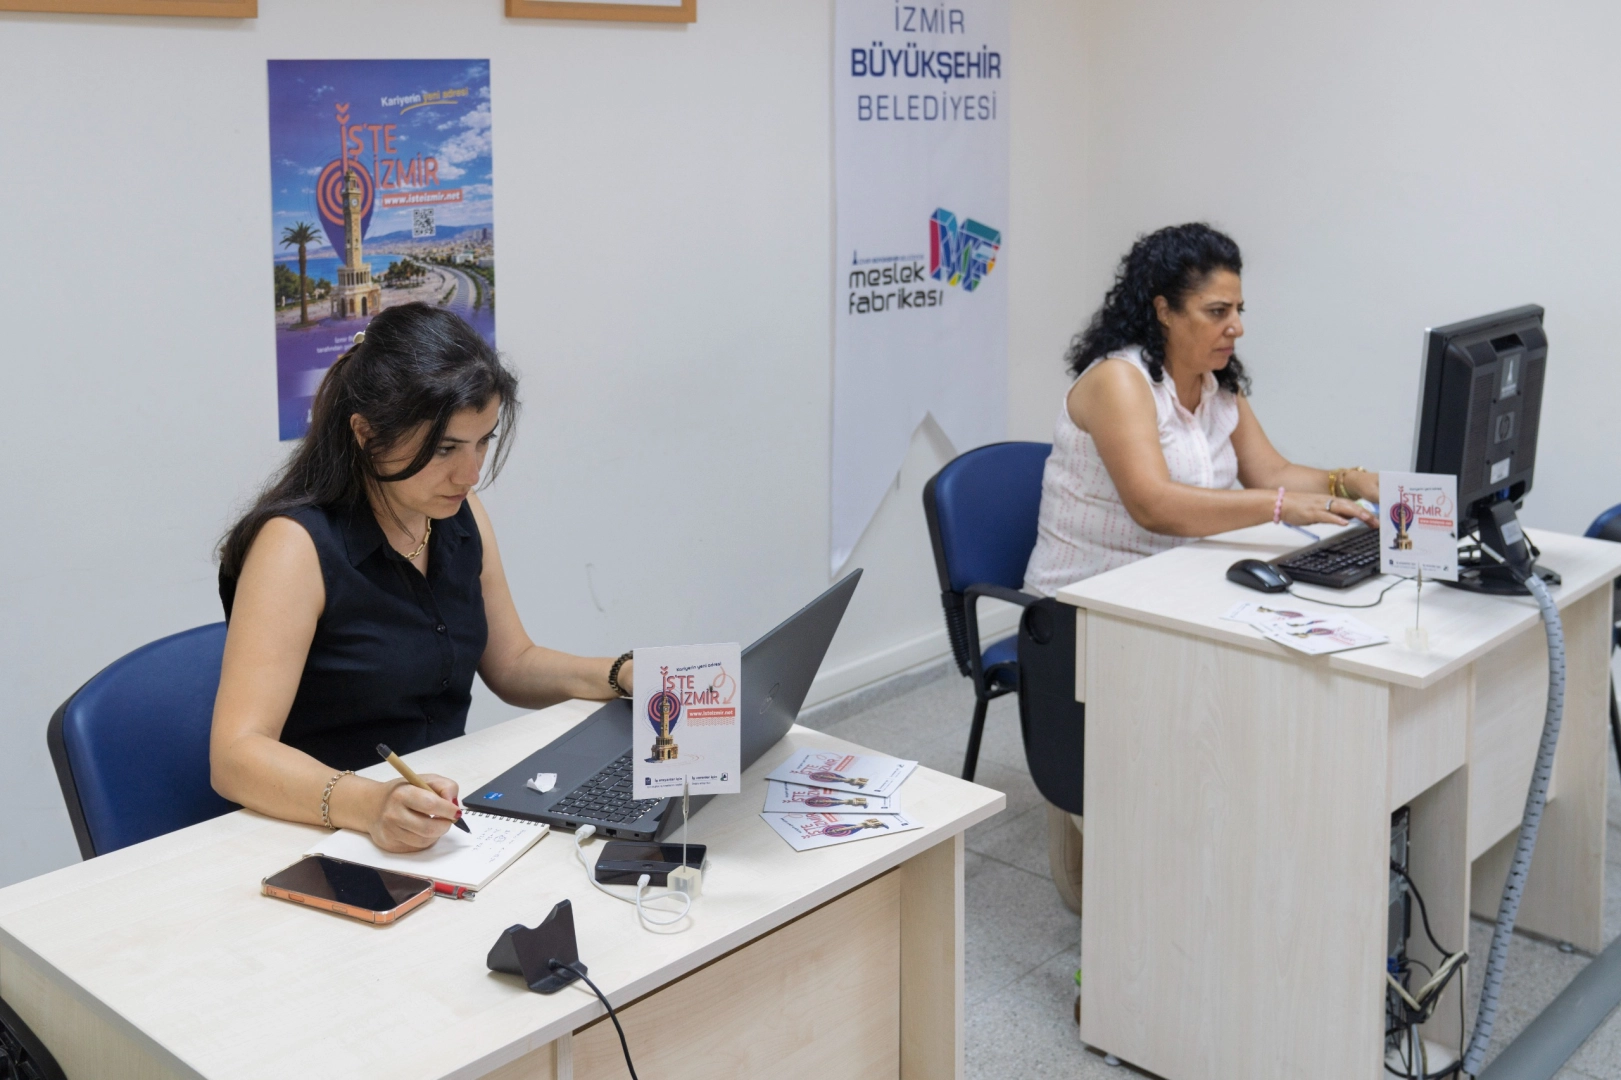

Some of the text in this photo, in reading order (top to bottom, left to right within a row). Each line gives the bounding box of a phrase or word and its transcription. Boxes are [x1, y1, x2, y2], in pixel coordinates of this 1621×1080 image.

[894, 0, 965, 34] İZMİR
[851, 41, 1001, 84] BÜYÜKŞEHİR
[381, 93, 421, 107] Kariyerin
[858, 91, 996, 121] BELEDİYESİ
[373, 152, 440, 190] İZMİR
[384, 191, 461, 206] www.isteizmir.net
[849, 261, 925, 289] meslek
[849, 288, 943, 315] fabrikası
[680, 688, 720, 706] İZMİR
